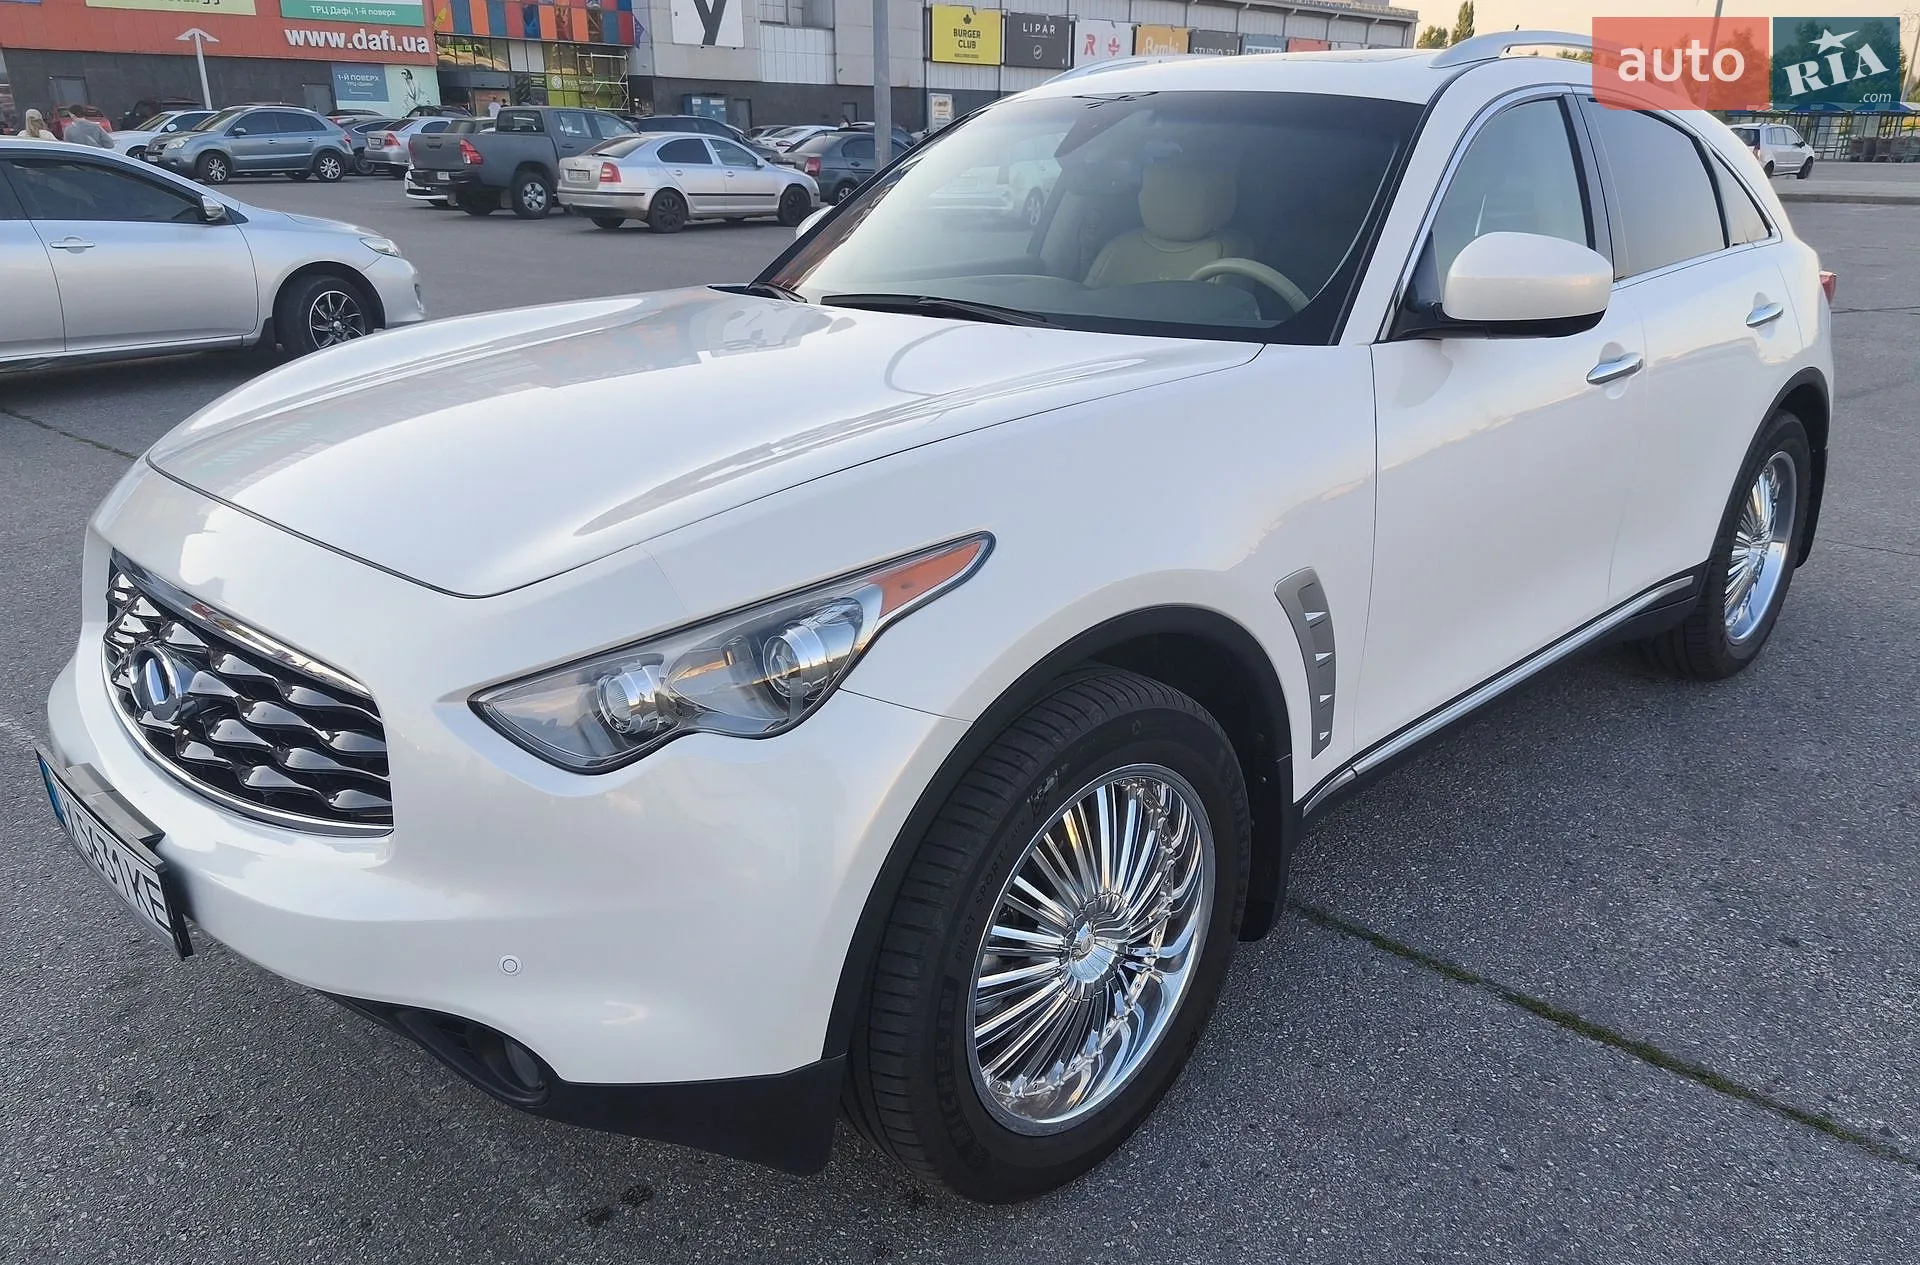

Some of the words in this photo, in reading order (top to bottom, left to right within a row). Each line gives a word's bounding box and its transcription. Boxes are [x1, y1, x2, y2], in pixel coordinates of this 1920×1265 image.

[310, 6, 329, 15] ТРЦ
[330, 6, 354, 16] Дафі,
[354, 7, 367, 15] 1-й
[953, 28, 981, 39] BURGER
[1022, 22, 1056, 35] LIPAR
[284, 28, 430, 53] www.dafi.ua
[957, 39, 977, 49] CLUB
[954, 913, 976, 961] PILOT
[975, 851, 1007, 906] SPORT
